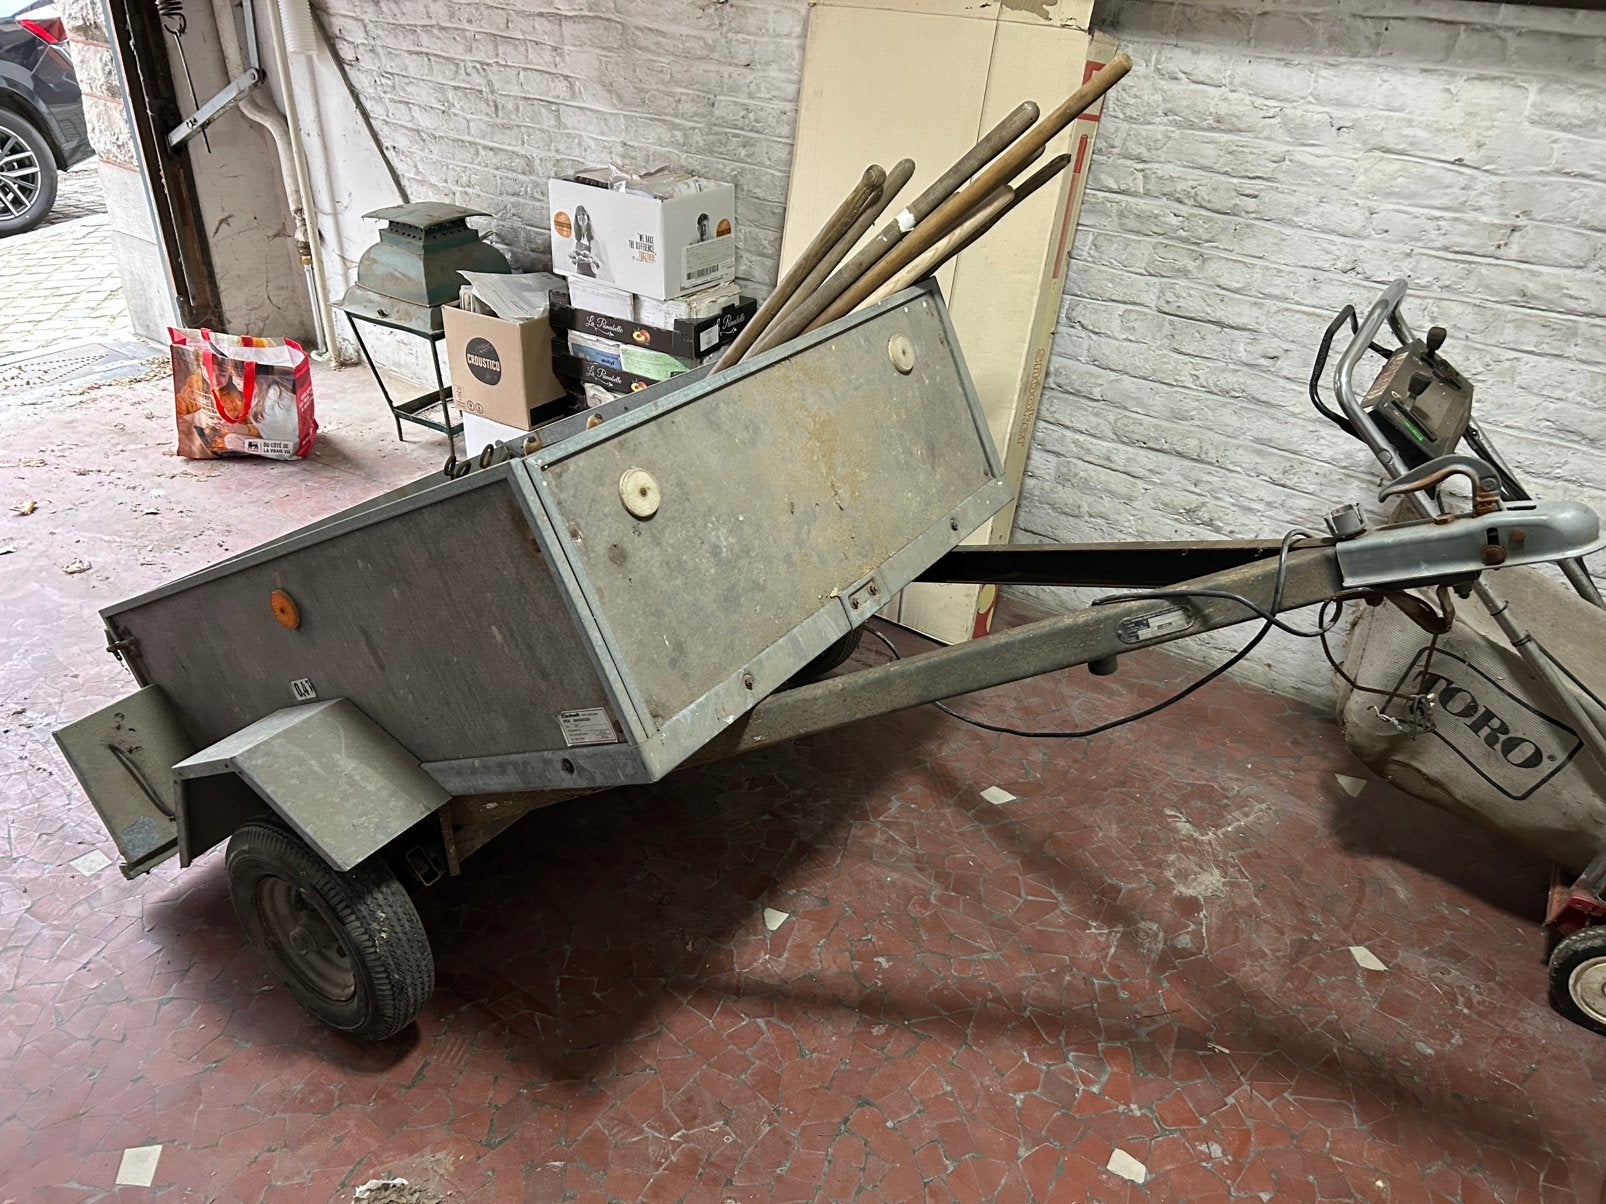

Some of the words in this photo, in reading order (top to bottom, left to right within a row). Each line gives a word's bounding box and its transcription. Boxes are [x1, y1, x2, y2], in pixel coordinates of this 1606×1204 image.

[467, 353, 500, 372] CROUSTICO
[1017, 348, 1044, 447] Snooker
[1413, 669, 1543, 769] TORO
